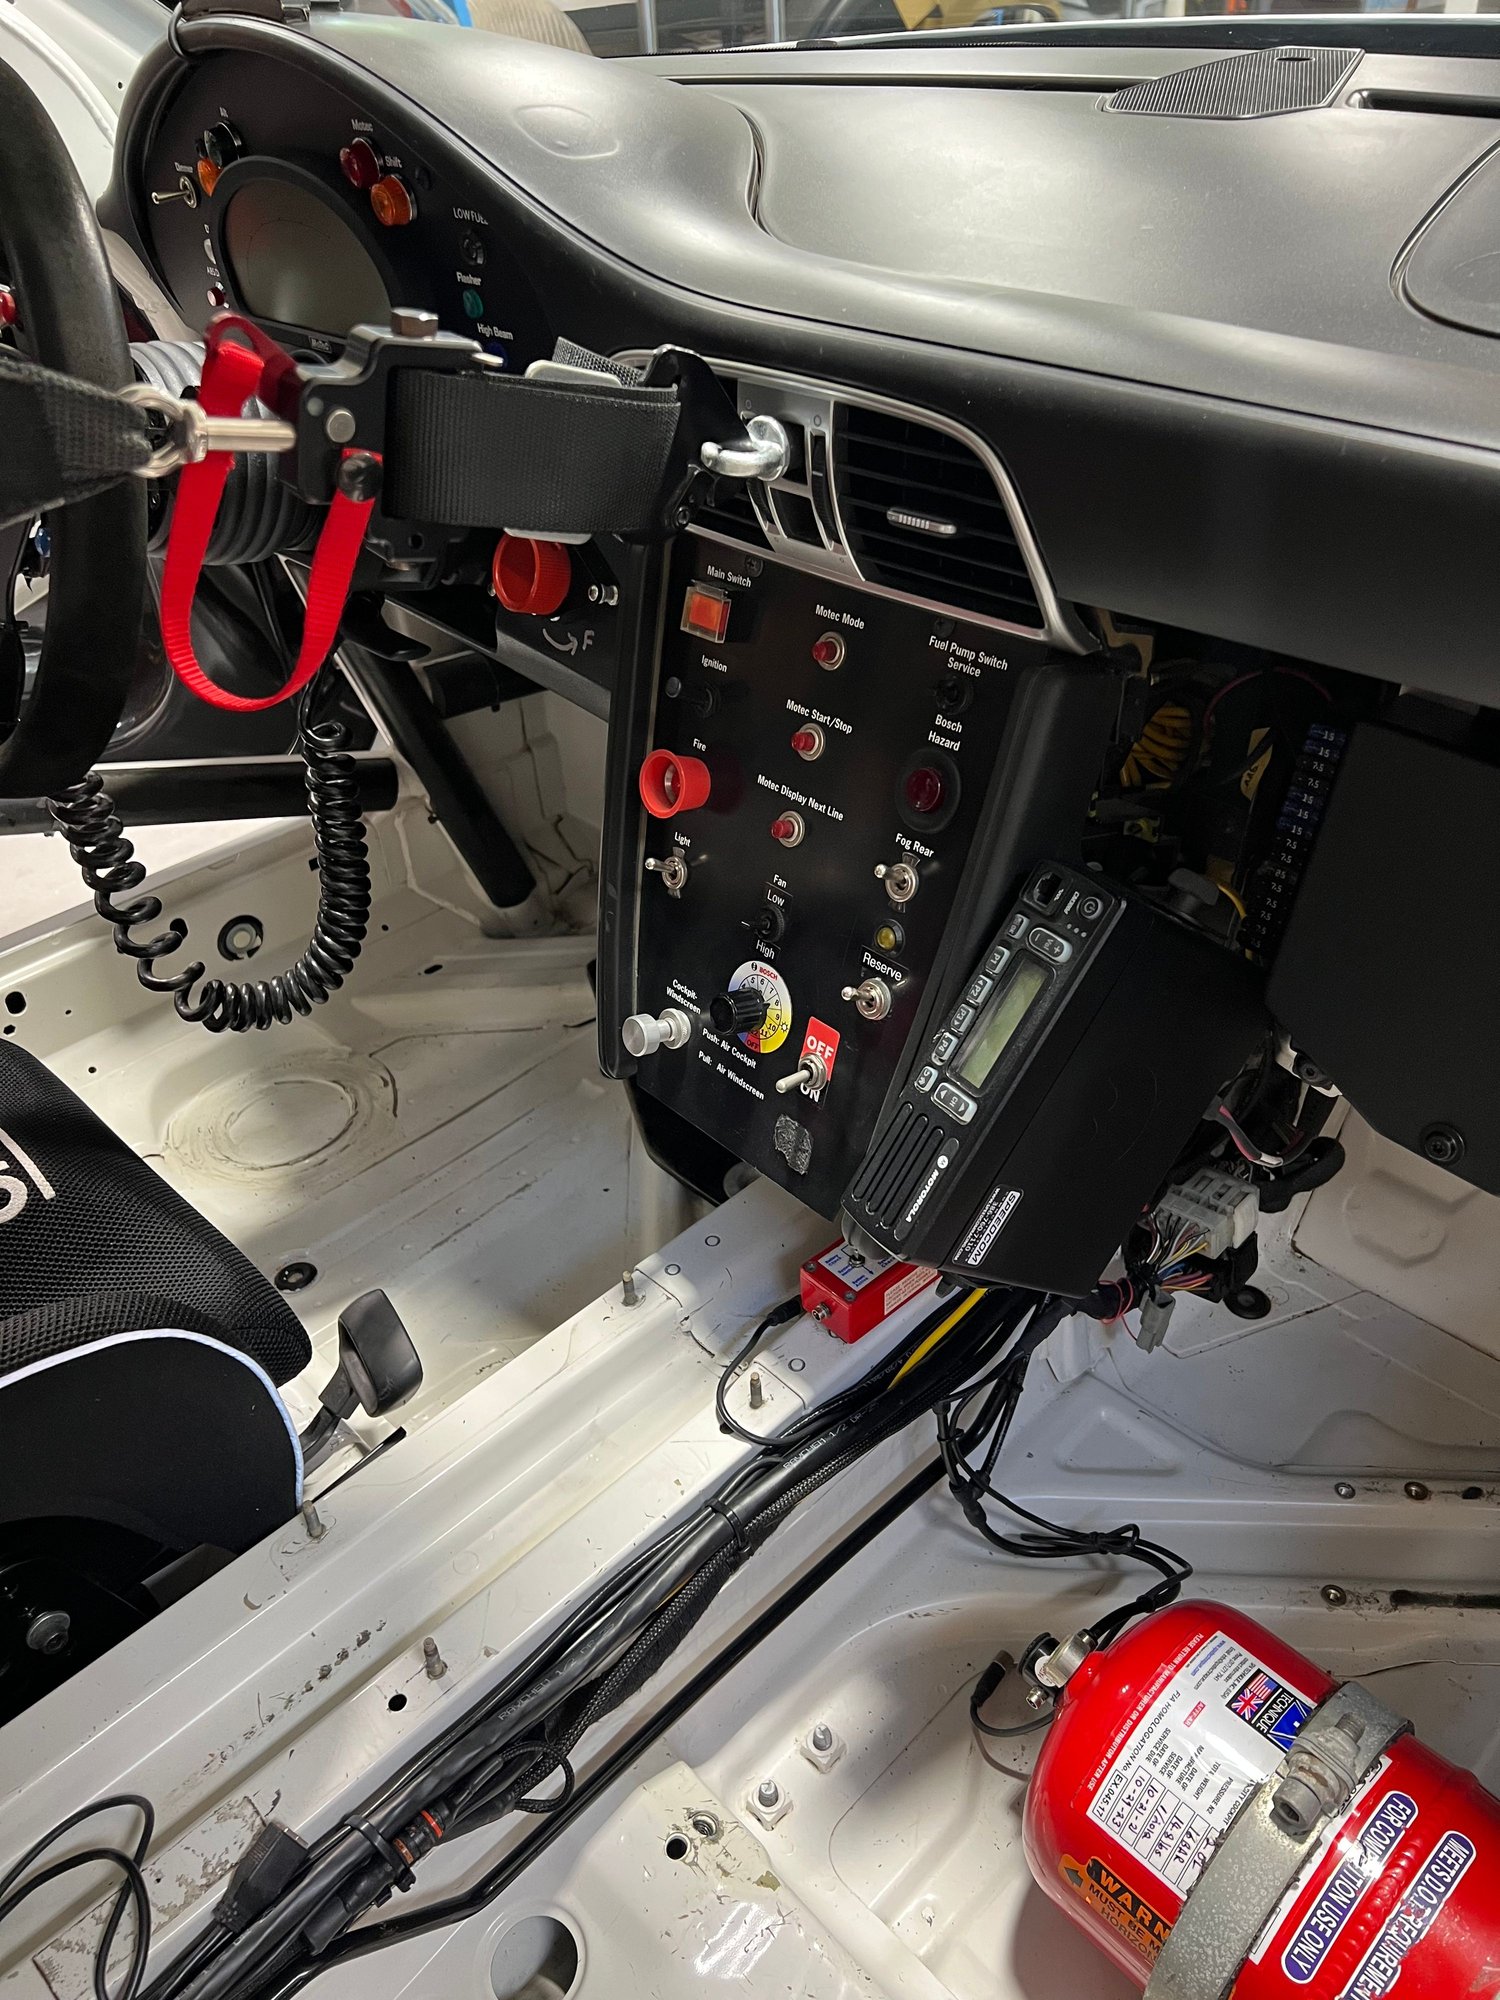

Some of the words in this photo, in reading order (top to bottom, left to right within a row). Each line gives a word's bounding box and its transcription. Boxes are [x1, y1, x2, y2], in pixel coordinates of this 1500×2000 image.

[450, 206, 471, 221] LOW
[475, 322, 494, 337] High
[491, 326, 514, 340] Beam
[707, 565, 726, 580] Main
[728, 571, 751, 588] Switch
[815, 604, 838, 622] Motec
[840, 611, 865, 630] Mode
[582, 629, 594, 650] F
[702, 655, 727, 672] Ignition
[929, 635, 949, 653] Fuel
[950, 642, 975, 663] Pump
[977, 649, 1008, 671] Switch
[947, 657, 980, 678] Service
[786, 699, 810, 717] Motec
[811, 707, 853, 735] Start/Stop
[935, 714, 962, 733] Bosch
[693, 738, 706, 751] Fire
[928, 730, 960, 752] Hazard
[757, 774, 779, 793] Motec
[780, 783, 807, 809] Display
[808, 796, 828, 814] Next
[828, 804, 844, 822] Line
[674, 832, 691, 847] Light
[896, 833, 914, 851] Fog
[914, 839, 934, 858] Rear
[1284, 838, 1298, 849] 7.5
[1279, 852, 1292, 863] 7.5
[773, 874, 788, 889] Fan
[767, 890, 784, 907] Low
[756, 939, 775, 961] High
[1041, 936, 1054, 951] Vol
[862, 952, 903, 982] Reserve
[988, 951, 1001, 965] P1
[757, 966, 779, 979] BOSCH
[666, 987, 701, 1014] Windscreen
[672, 979, 698, 1001] Cockpit-
[968, 983, 982, 997] P2
[954, 1007, 967, 1021] P3
[759, 1028, 768, 1037] 11
[767, 1023, 776, 1031] 10
[702, 1028, 720, 1045] Push:
[720, 1038, 732, 1054] Air
[731, 1044, 757, 1069] Cockpit
[745, 1039, 759, 1049] OFF
[806, 1034, 835, 1061] OFF
[936, 1038, 949, 1053] P4
[698, 1051, 712, 1066] Pull:
[716, 1062, 729, 1077] Air
[728, 1066, 765, 1100] Windscreen
[905, 1168, 942, 1223] MOTOROLA
[970, 1192, 1017, 1263] SPEEDCOM
[1187, 1631, 1202, 1648] PLEASE
[1173, 1644, 1190, 1665] RETURN
[1167, 1662, 1176, 1670] TO
[498, 1677, 551, 1721] RAYCHEM
[1135, 1667, 1169, 1712] MANUFACTURER
[1169, 1689, 1180, 1702] FIA
[1129, 1710, 1139, 1720] OR
[1256, 1690, 1292, 1734] TECHNIQUE
[1104, 1719, 1133, 1759] DISTRIBUTOR
[1128, 1701, 1172, 1761] HOMOLOGATION
[1153, 1727, 1170, 1749] SERVICE
[1144, 1749, 1156, 1762] DUE
[1156, 1743, 1168, 1756] DATE
[1092, 1757, 1109, 1778] AFTER
[1120, 1759, 1133, 1773] No.
[1150, 1756, 1159, 1766] OF
[1157, 1751, 1176, 1775] SERVICE
[1170, 1755, 1182, 1769] DATE
[1086, 1777, 1097, 1790] USE
[1164, 1769, 1173, 1778] OF
[1186, 1767, 1197, 1781] DATE
[1092, 1774, 1124, 1816] EX.045.17
[1179, 1780, 1188, 1791] OF
[1192, 1777, 1209, 1799] WEIGHT
[1211, 1776, 1233, 1804] PRESSURE
[1205, 1804, 1215, 1814] N2
[1221, 1799, 1241, 1825] COCKPIT
[1382, 1798, 1410, 1826] FOR
[1430, 1838, 1468, 1880] MEETS
[1086, 1883, 1124, 1918] MUST
[1126, 1920, 1146, 1939] BE
[1312, 1902, 1342, 1934] USE
[1286, 1930, 1326, 1972] ONLY
